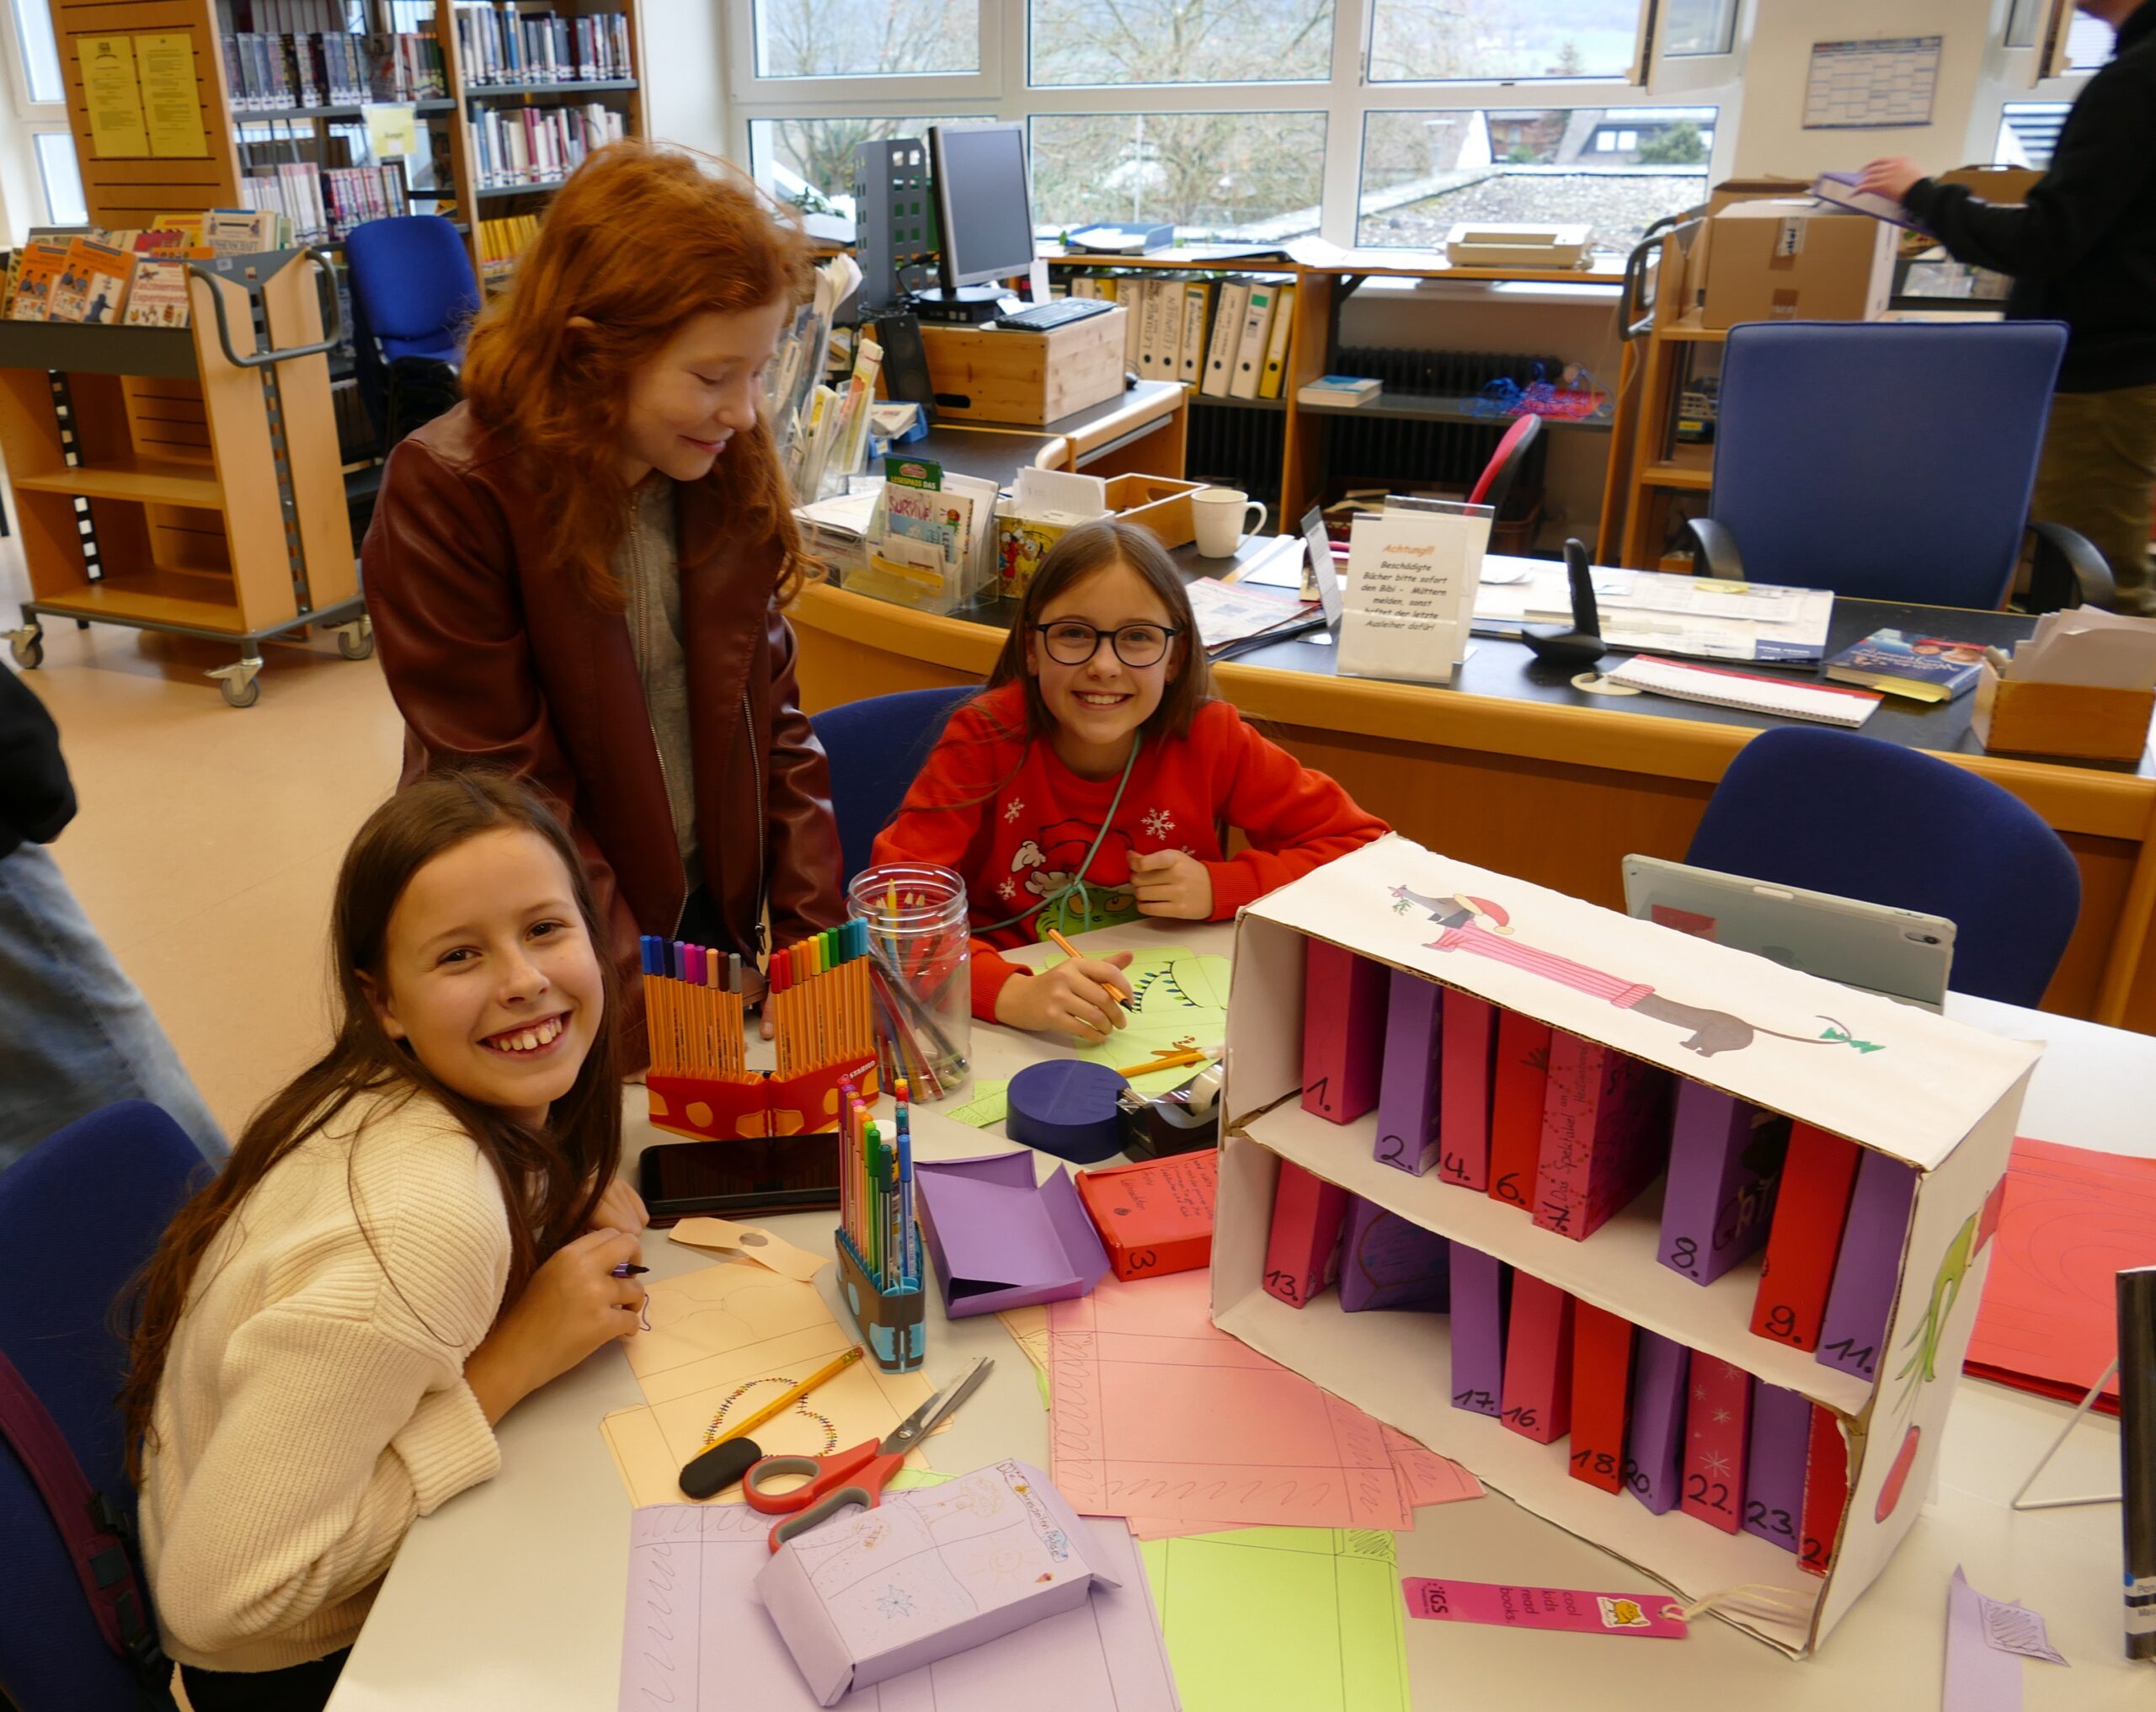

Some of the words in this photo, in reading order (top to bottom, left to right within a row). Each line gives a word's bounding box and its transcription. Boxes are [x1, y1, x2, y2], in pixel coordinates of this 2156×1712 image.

[1363, 572, 1391, 581] Bücher
[1395, 573, 1417, 583] bitte
[1420, 575, 1448, 584] sofort
[1380, 561, 1432, 573] Beschädigte
[1361, 584, 1377, 592] den
[1379, 584, 1396, 593] Bibi
[1411, 586, 1447, 596] Müttern
[1409, 599, 1432, 607] sonst
[1365, 620, 1404, 630] Ausleiher
[1395, 609, 1410, 617] der
[1413, 611, 1439, 620] letzte
[849, 1060, 876, 1080] STABILO
[1307, 1075, 1331, 1112] 1.
[1380, 1134, 1413, 1171] 2.
[1553, 1115, 1577, 1175] Spektakel
[1444, 1151, 1471, 1181] 4.
[1496, 1172, 1526, 1206] 6.
[1550, 1181, 1569, 1202] Das
[1542, 1201, 1571, 1232] 7.
[1670, 1237, 1700, 1277] 8.
[1266, 1270, 1299, 1302] 13.
[1765, 1305, 1802, 1343] 9.
[1824, 1338, 1873, 1373] 11.
[1454, 1389, 1495, 1411] 17.
[1502, 1406, 1540, 1432] 16.
[1572, 1449, 1616, 1480] 18.
[1688, 1474, 1732, 1514] 22.
[1747, 1501, 1796, 1539] 23.
[1801, 1538, 1832, 1566] 2
[1499, 1587, 1515, 1624] books.
[1519, 1588, 1540, 1614] read
[1541, 1590, 1560, 1613] kids
[1562, 1591, 1582, 1617] cool
